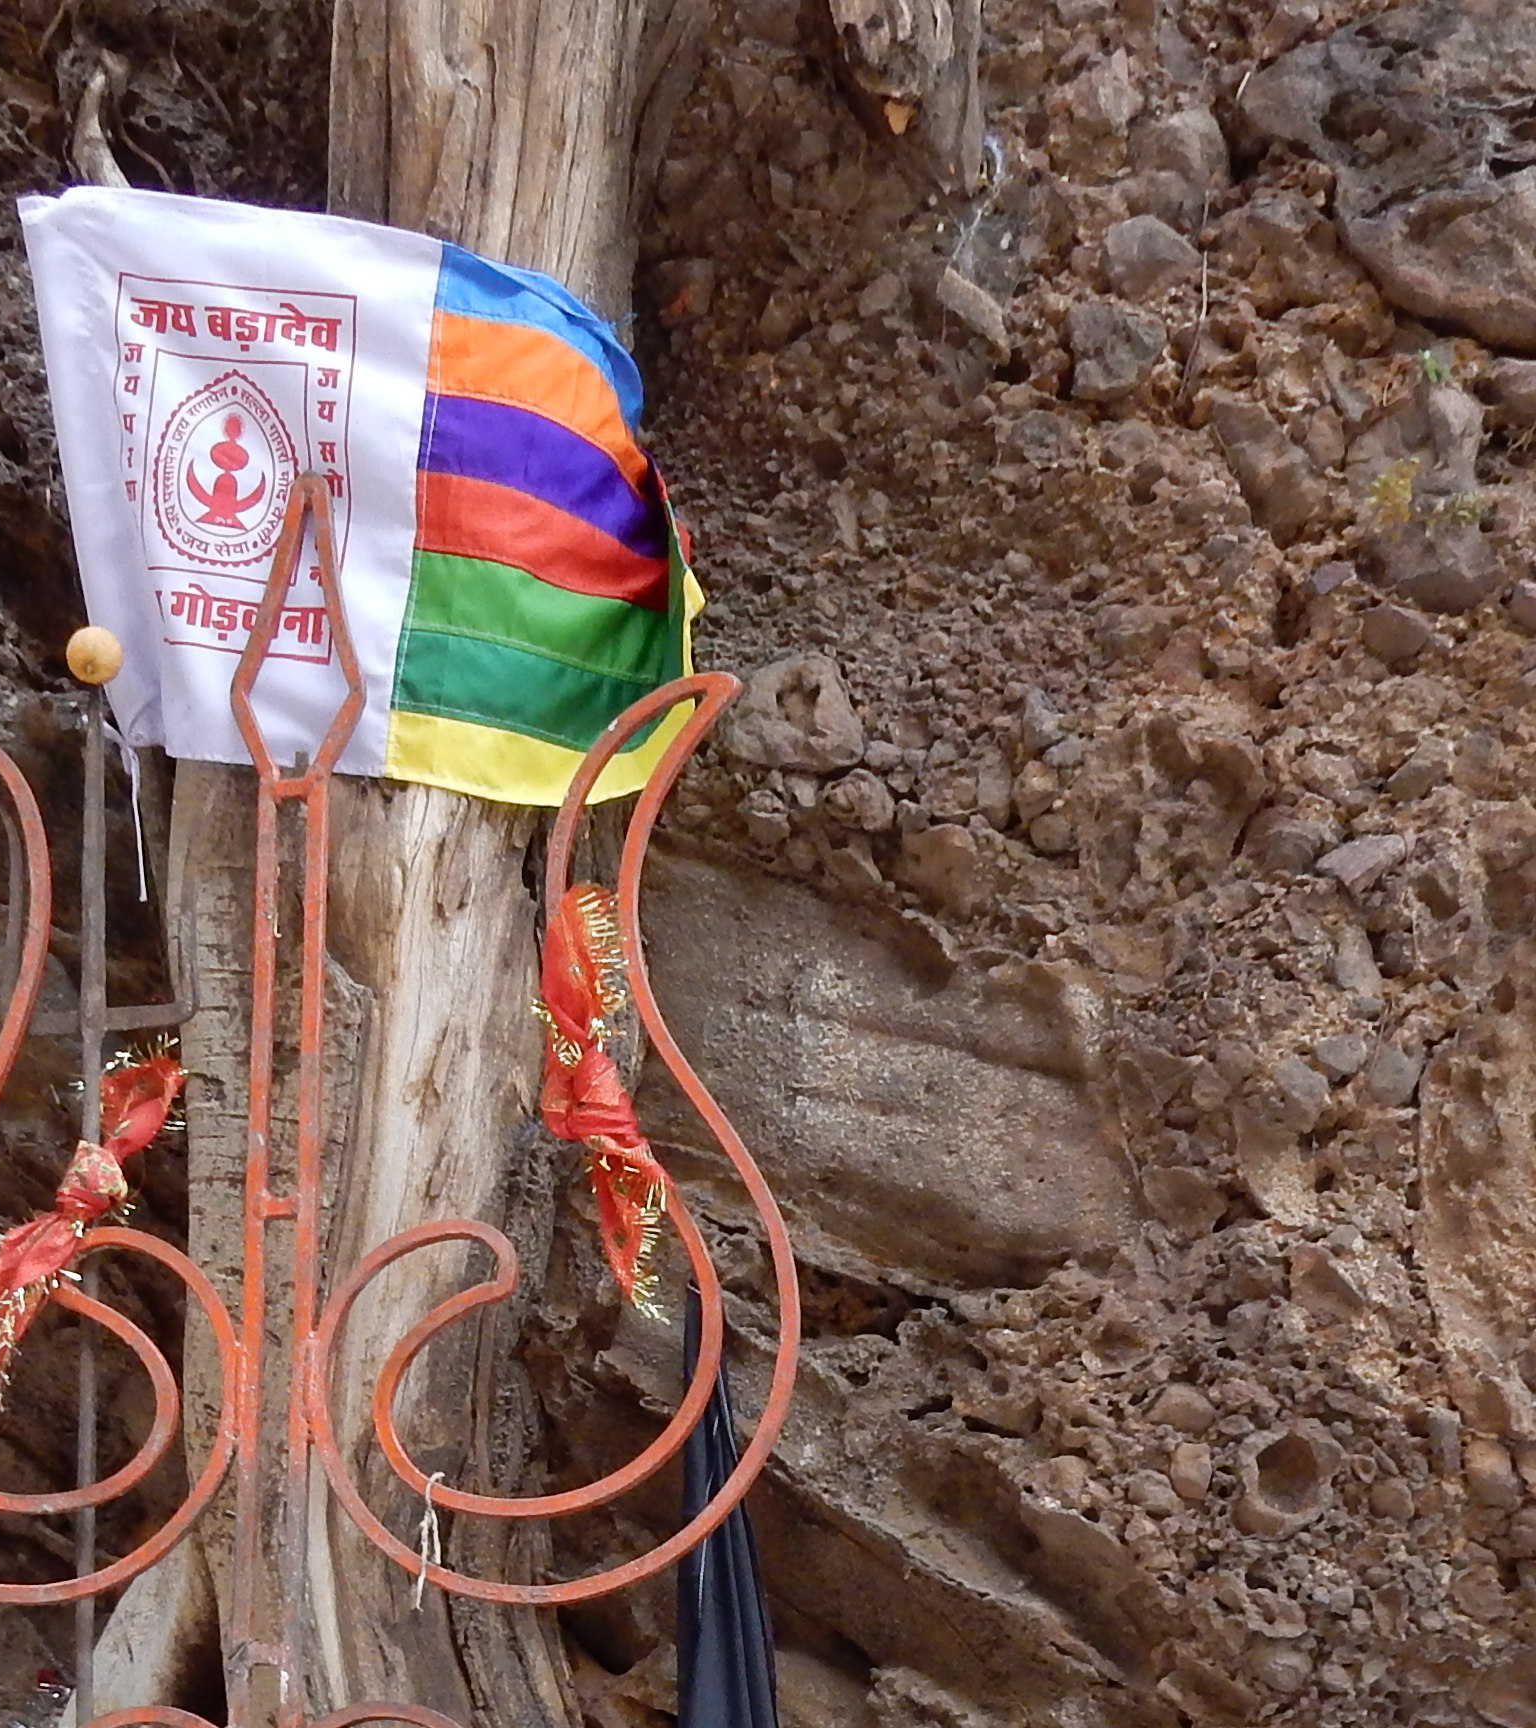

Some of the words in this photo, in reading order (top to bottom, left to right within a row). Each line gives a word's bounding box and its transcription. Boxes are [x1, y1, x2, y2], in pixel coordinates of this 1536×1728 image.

[130, 297, 197, 337] जय
[204, 302, 342, 352] बड़ादेव
[181, 531, 210, 554] जय
[214, 540, 250, 557] सेवा
